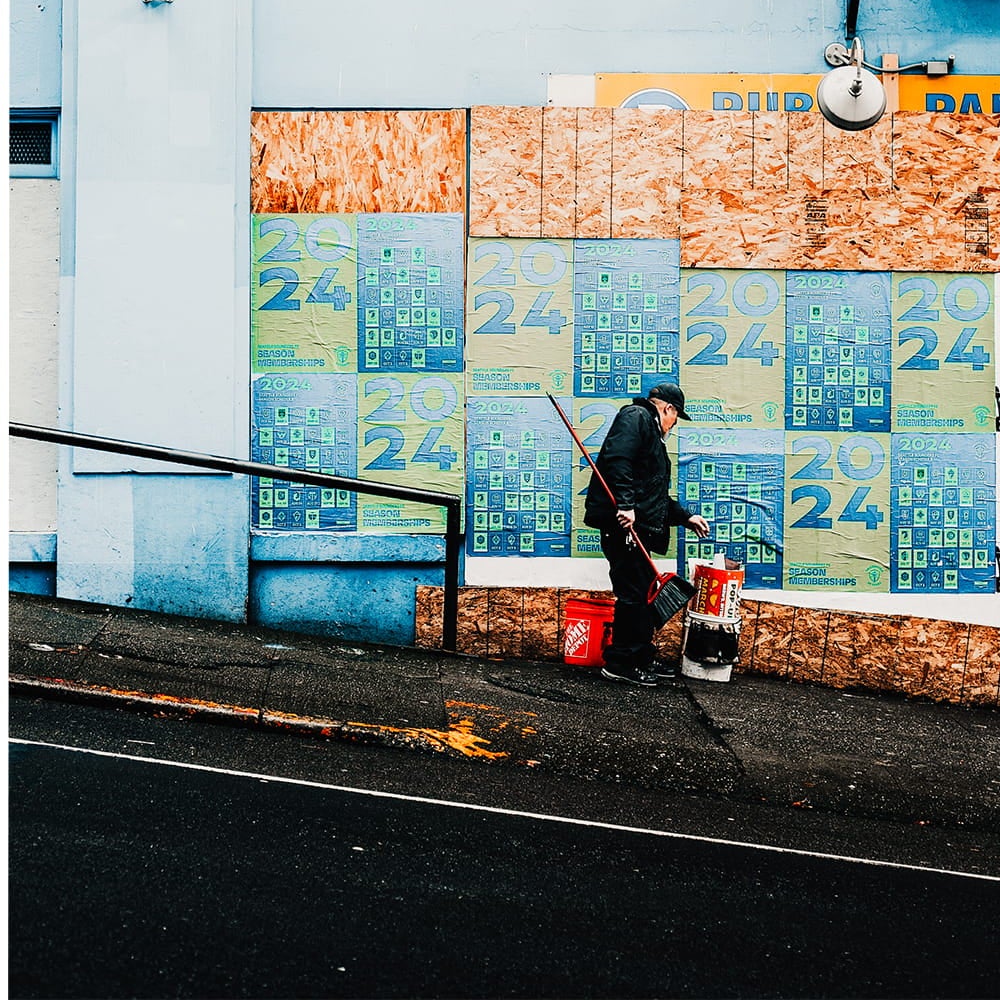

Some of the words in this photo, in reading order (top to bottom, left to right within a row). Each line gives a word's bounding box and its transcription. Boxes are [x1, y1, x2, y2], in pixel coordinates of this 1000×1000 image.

[258, 217, 352, 263] 20
[366, 218, 416, 230] 2024
[474, 240, 568, 286] 20
[584, 243, 636, 256] 2024
[259, 267, 352, 311] 24
[686, 272, 780, 317] 20
[795, 276, 846, 289] 2024
[898, 276, 991, 322] 20
[474, 291, 567, 334] 24
[686, 322, 779, 366] 24
[898, 326, 990, 371] 24
[260, 378, 311, 391] 2024
[473, 373, 510, 381] SEASON
[363, 376, 458, 422] 20
[475, 401, 527, 414] 2024
[364, 426, 457, 471] 24
[687, 433, 739, 446] 2024
[791, 435, 886, 481] 20
[899, 438, 951, 451] 2024
[792, 485, 884, 530] 24
[577, 535, 600, 543] SEAS
[789, 568, 826, 576] SEASON
[698, 577, 709, 614] MARCH
